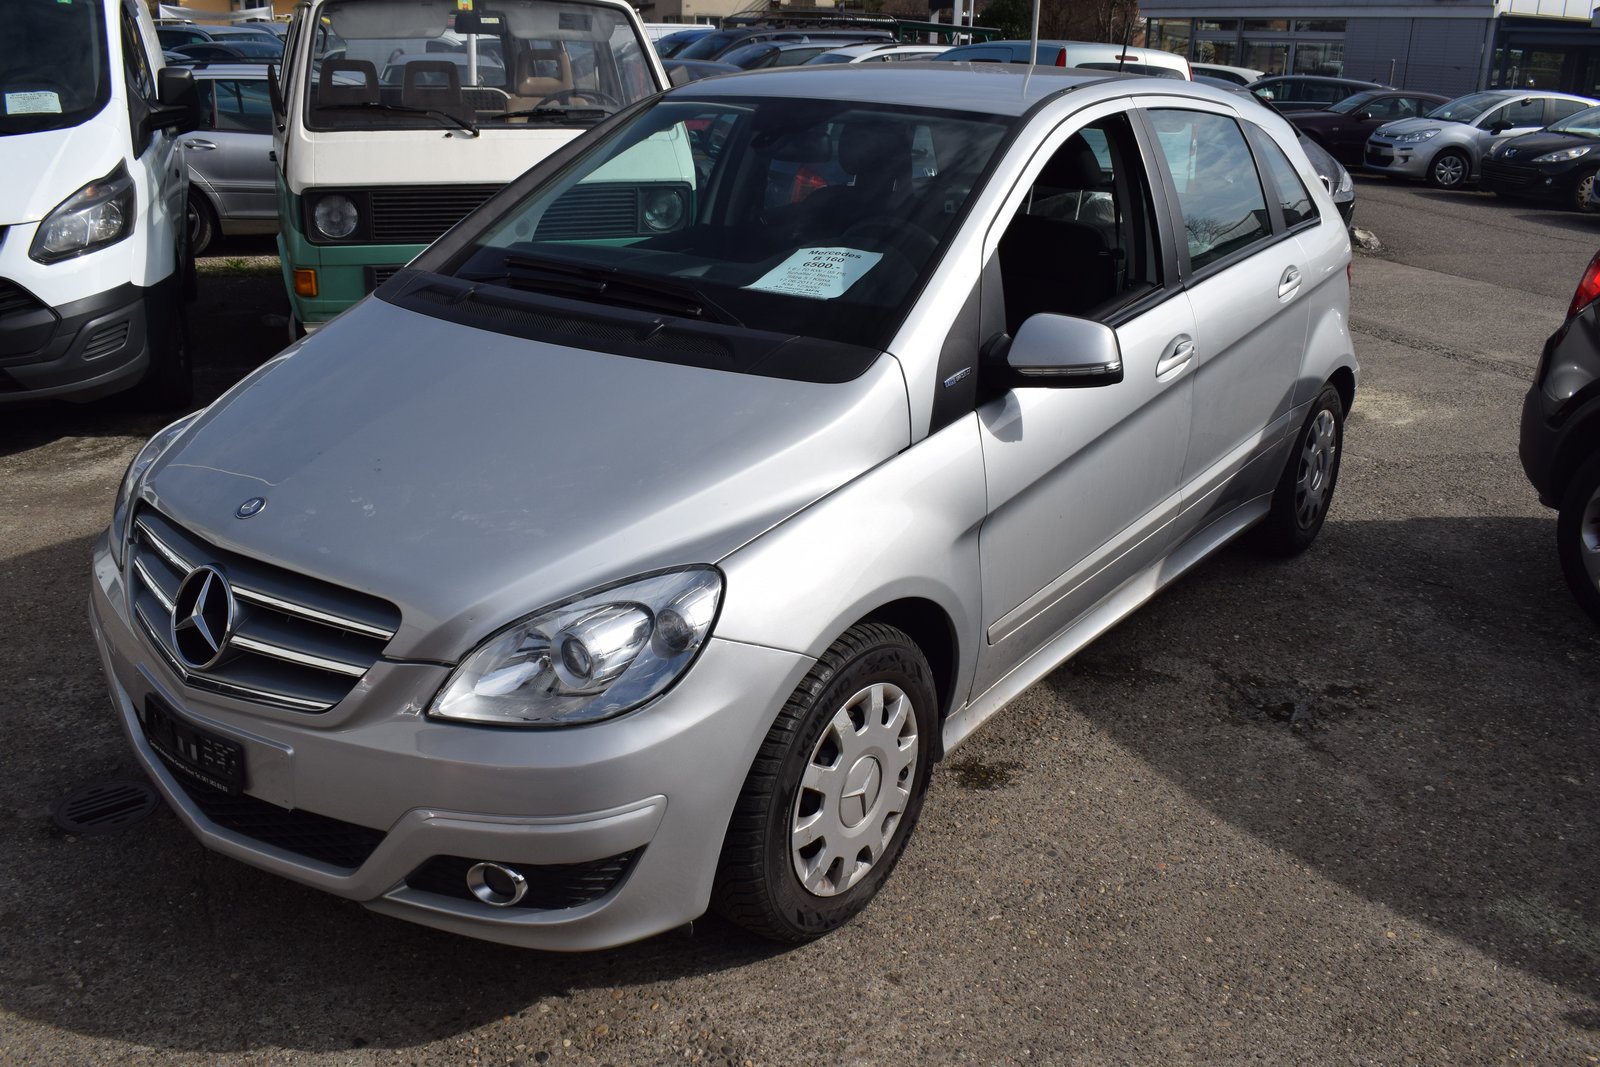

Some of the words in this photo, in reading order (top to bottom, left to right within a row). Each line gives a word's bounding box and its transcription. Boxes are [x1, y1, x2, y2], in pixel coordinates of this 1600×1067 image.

[808, 250, 862, 259] Mercedes
[802, 261, 841, 269] 6500.-
[796, 676, 852, 760] KUMHO
